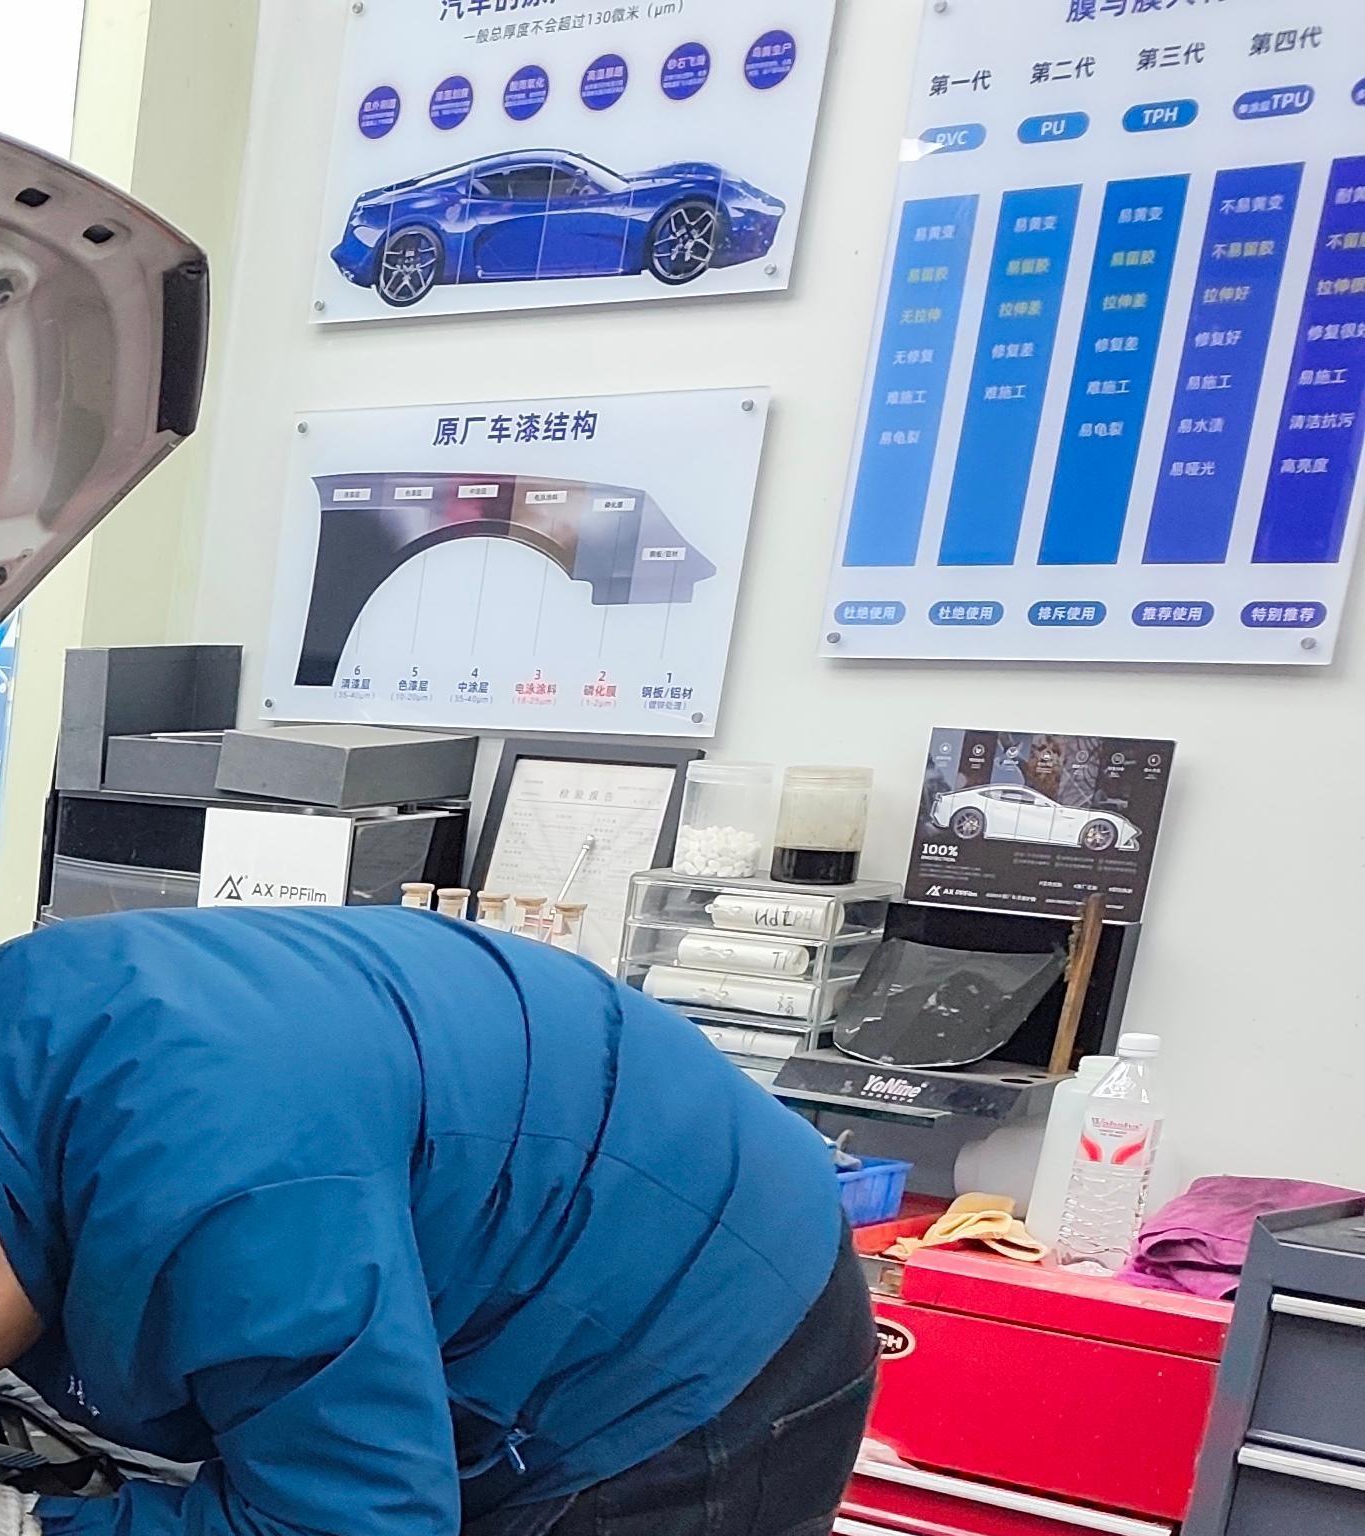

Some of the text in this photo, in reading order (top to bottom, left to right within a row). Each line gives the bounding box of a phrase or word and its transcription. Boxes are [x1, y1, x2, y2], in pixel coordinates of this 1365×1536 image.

[1249, 26, 1323, 57] 第四代
[1136, 42, 1206, 72] 第三代
[1030, 56, 1096, 84] 第二代
[929, 69, 992, 97] 第一代
[1143, 106, 1179, 126] TPH
[1040, 120, 1066, 136] PU
[935, 131, 968, 146] PVC
[433, 410, 597, 446] 原厂车漆结构
[1037, 606, 1095, 622] 排斥使用
[1142, 606, 1202, 622] 推荐使用
[1251, 606, 1315, 623] 特别推荐
[354, 666, 361, 676] 6
[412, 667, 419, 677] 5
[471, 668, 479, 678] 4
[534, 670, 542, 680] 3
[598, 671, 606, 682] 2
[666, 673, 673, 684] 1
[921, 843, 959, 857] 100%
[252, 882, 327, 903] AX PPFilm
[863, 1074, 922, 1098] YoNine
